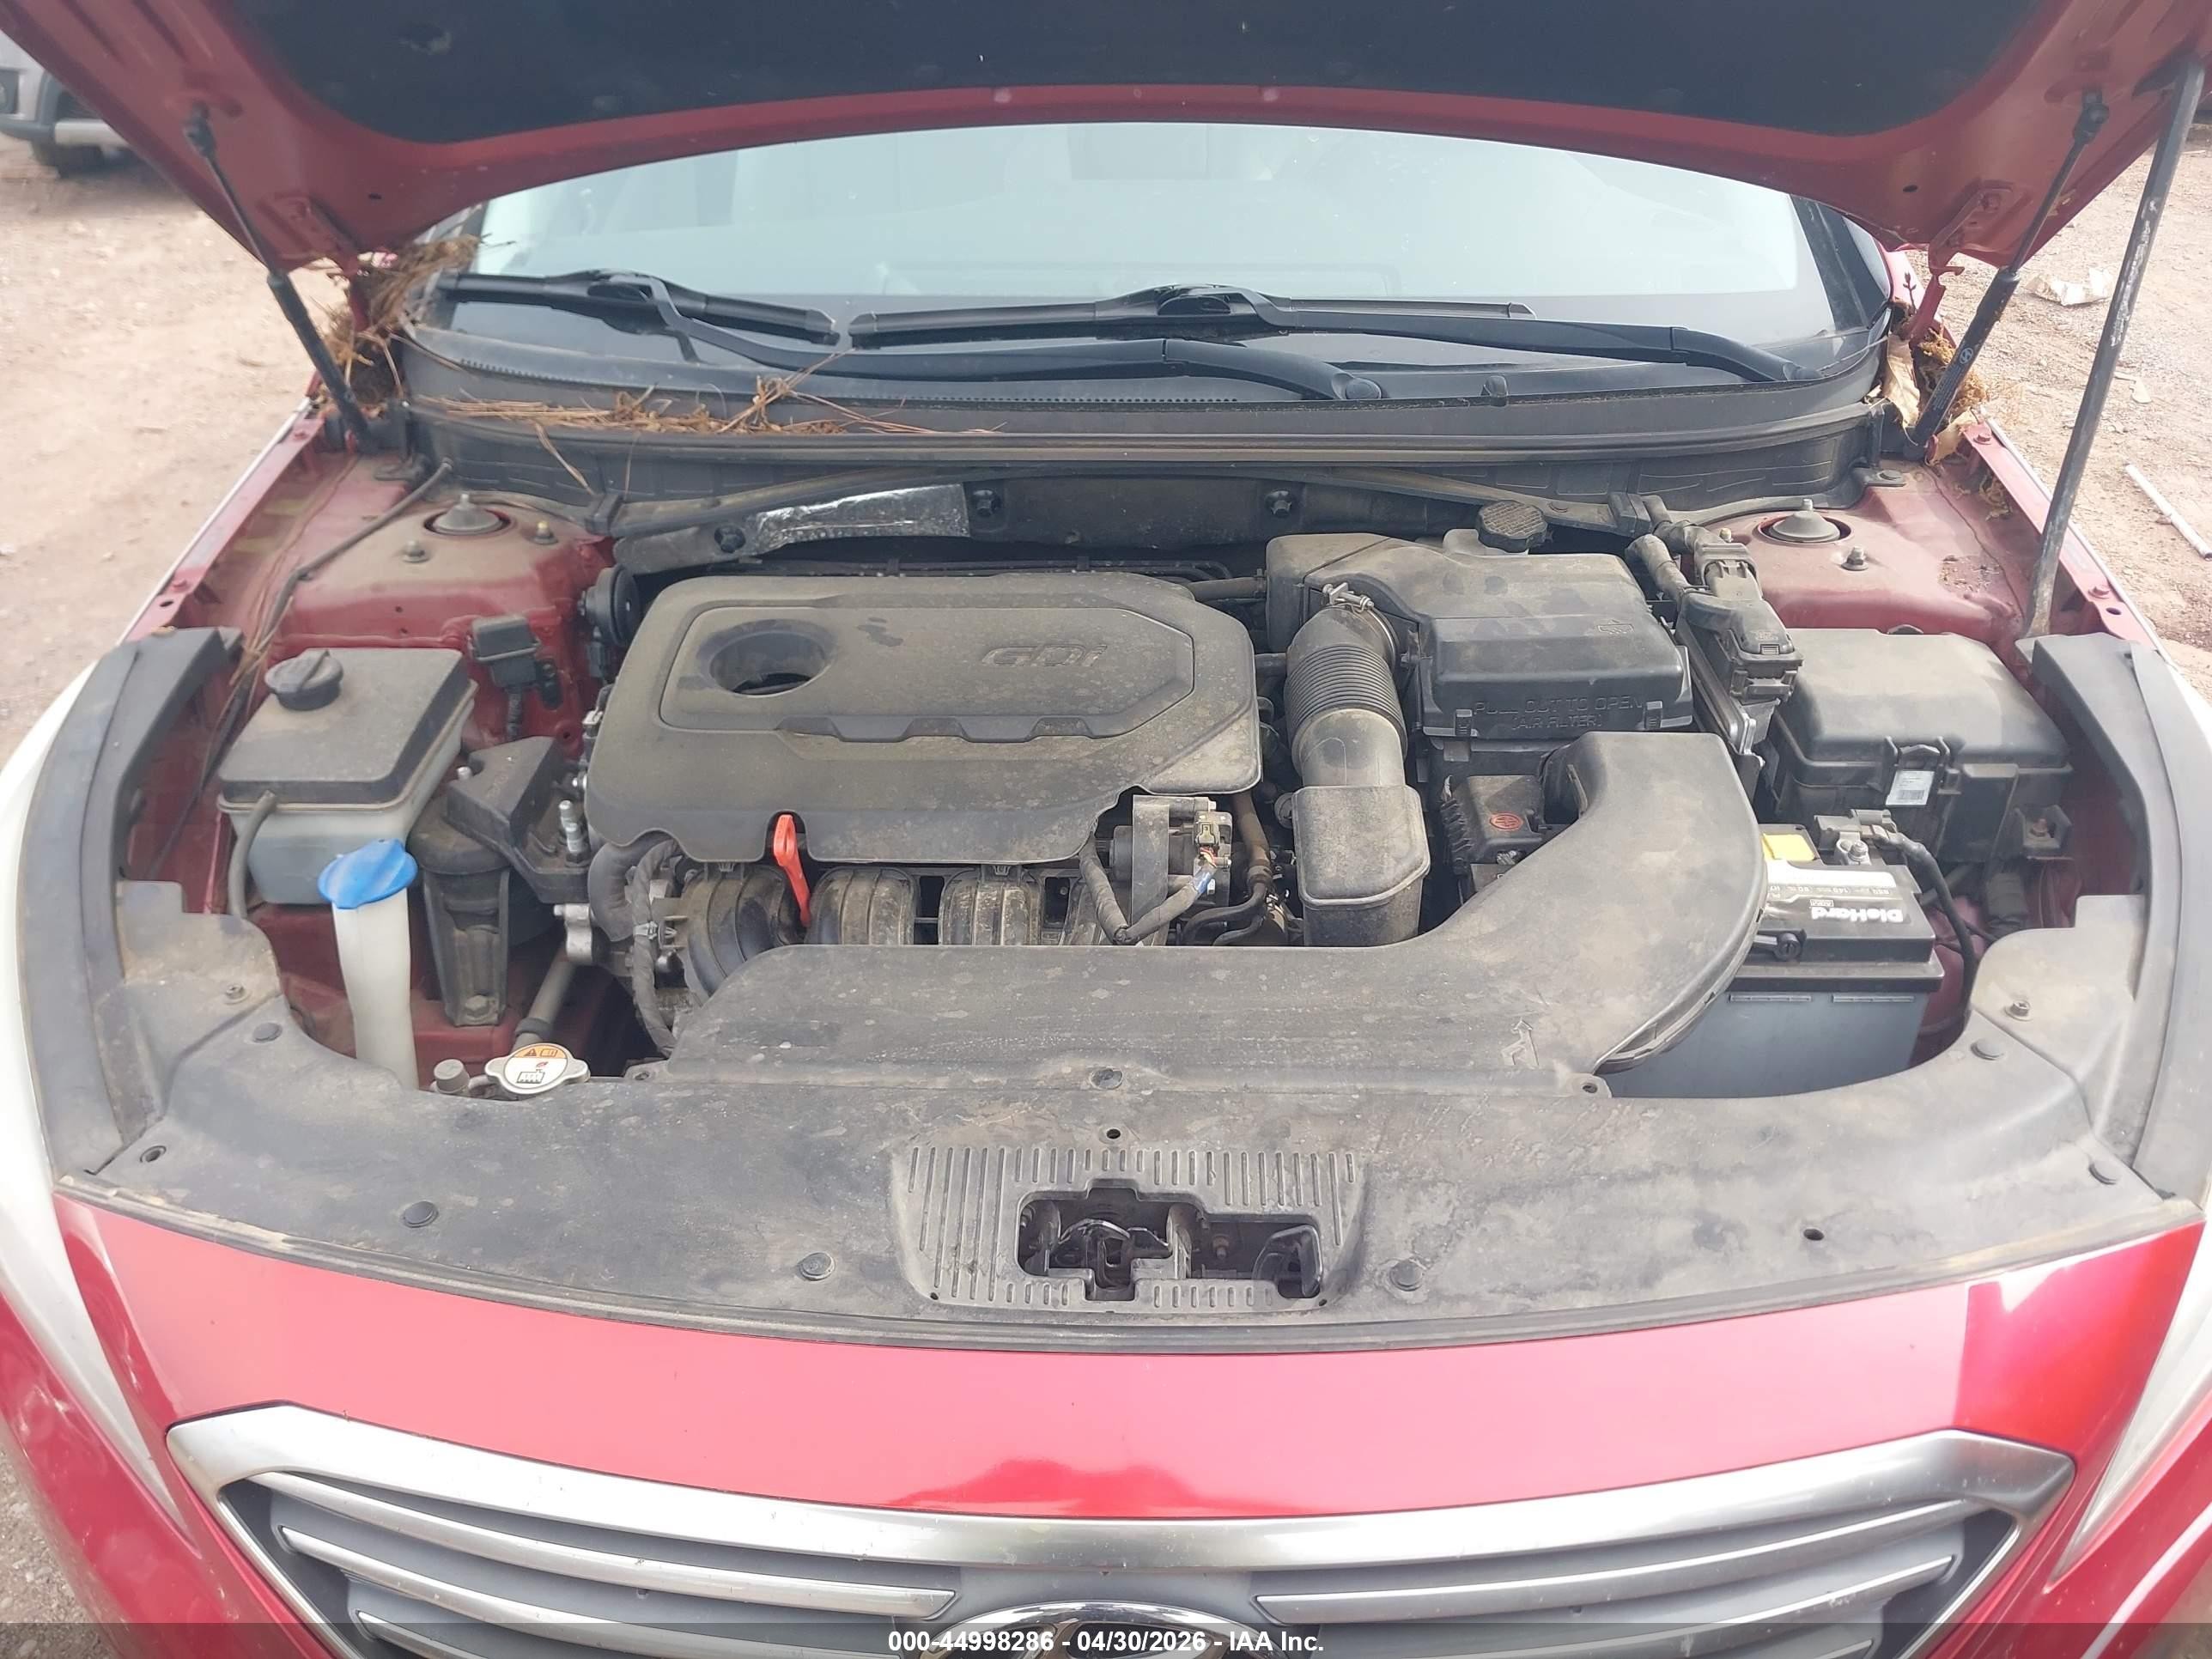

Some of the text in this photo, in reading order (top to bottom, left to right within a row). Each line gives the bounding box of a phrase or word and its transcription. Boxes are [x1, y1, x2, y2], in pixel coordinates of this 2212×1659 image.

[1524, 698, 1563, 714] OUT
[1565, 697, 1589, 712] TO
[1594, 695, 1644, 711] OPEN
[1811, 906, 1904, 923] DieHard
